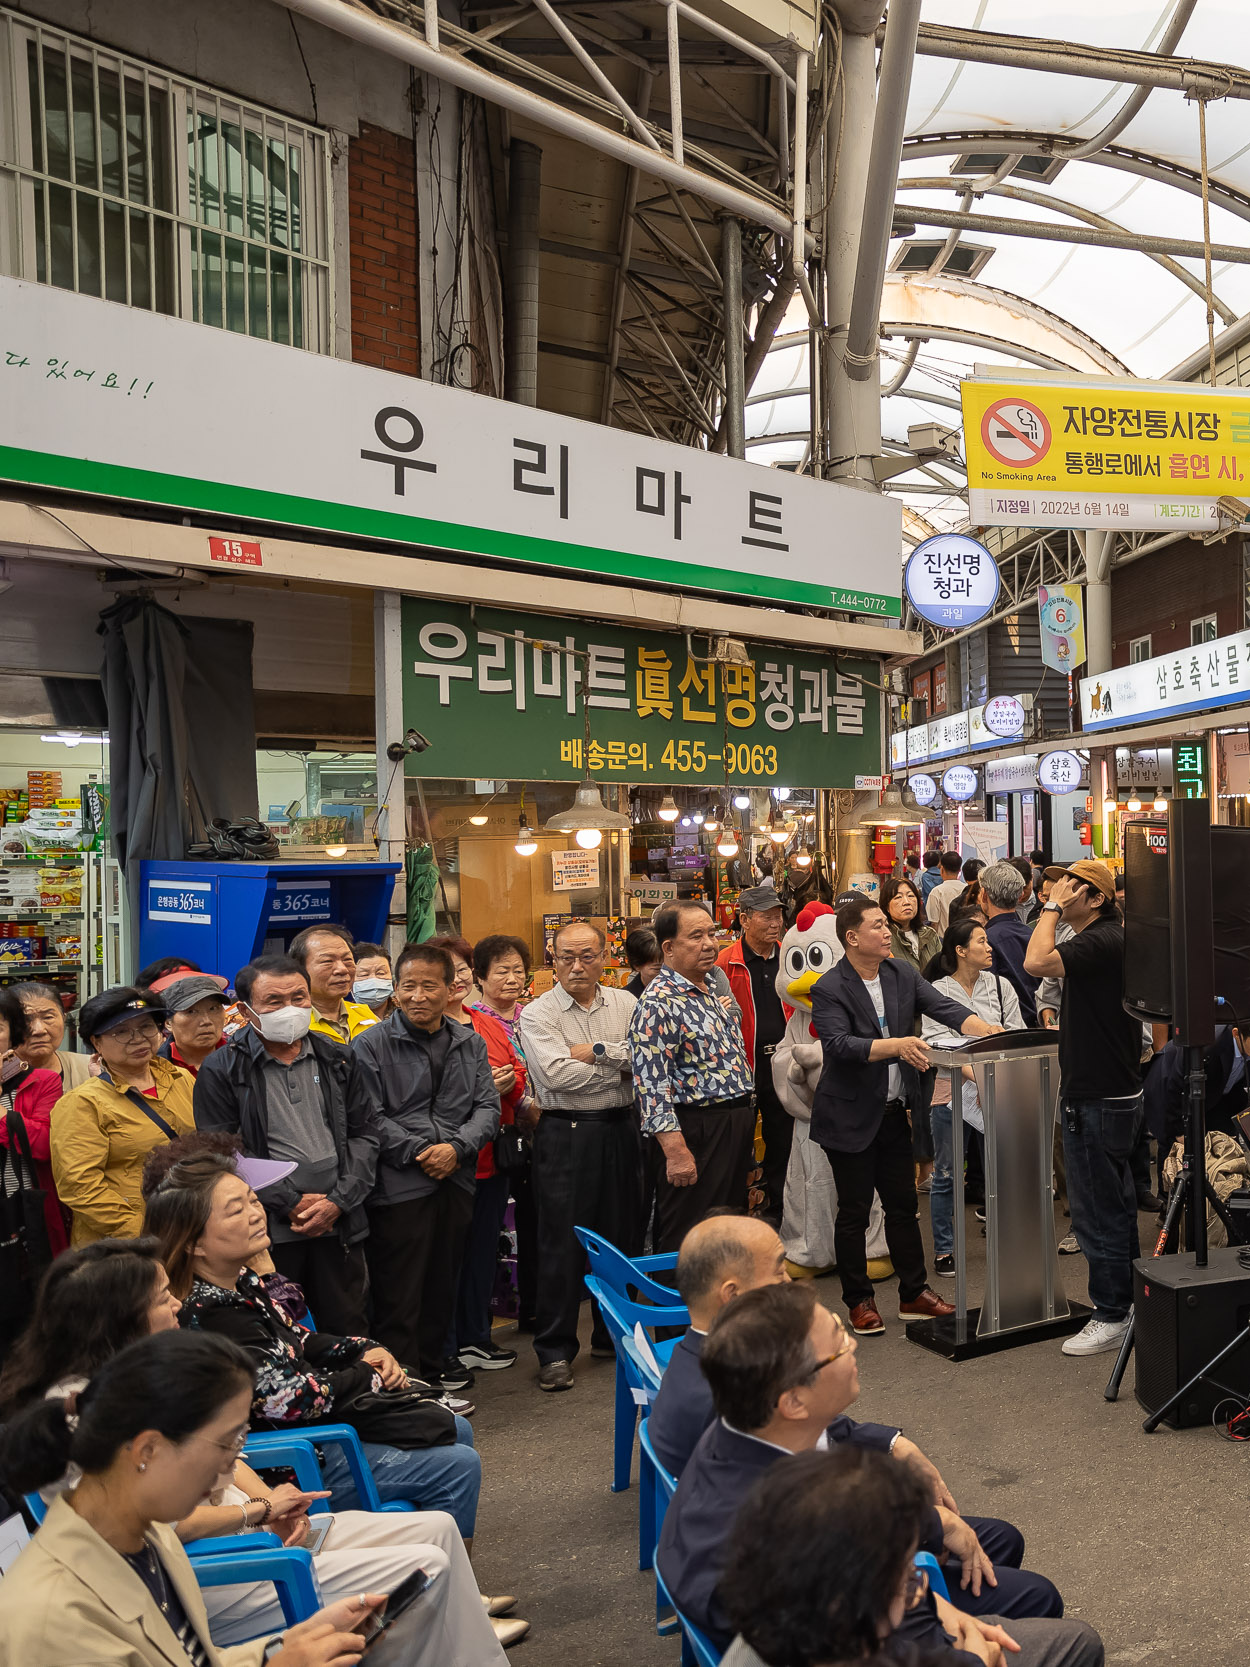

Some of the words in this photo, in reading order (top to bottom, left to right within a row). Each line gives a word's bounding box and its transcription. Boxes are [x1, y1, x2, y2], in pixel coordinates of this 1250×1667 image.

[6, 351, 30, 368] 다
[46, 358, 154, 399] 있어요!!
[1062, 405, 1220, 442] 자양전통시장
[1065, 451, 1161, 478] 통행로에서
[1168, 453, 1210, 480] 흡연
[1218, 455, 1244, 482] 시,
[361, 406, 789, 552] 우리마트
[981, 471, 994, 480] No
[996, 471, 1034, 482] Smoking
[1036, 472, 1057, 482] Area
[996, 499, 1030, 515] 지정일
[1041, 501, 1080, 515] 2022년
[1084, 502, 1102, 516] 6월
[1105, 503, 1130, 517] 14일
[1159, 503, 1200, 518] 계도기간
[222, 540, 243, 557] 15
[923, 553, 981, 576] 진선명
[933, 577, 973, 599] 청과
[831, 591, 887, 611] T.444-0772
[941, 608, 963, 620] 과일
[1056, 608, 1066, 623] 6
[560, 738, 654, 772] 배송문의.
[661, 739, 778, 776] 455-9063
[1050, 757, 1071, 769] 삼호
[1050, 770, 1071, 783] 축산
